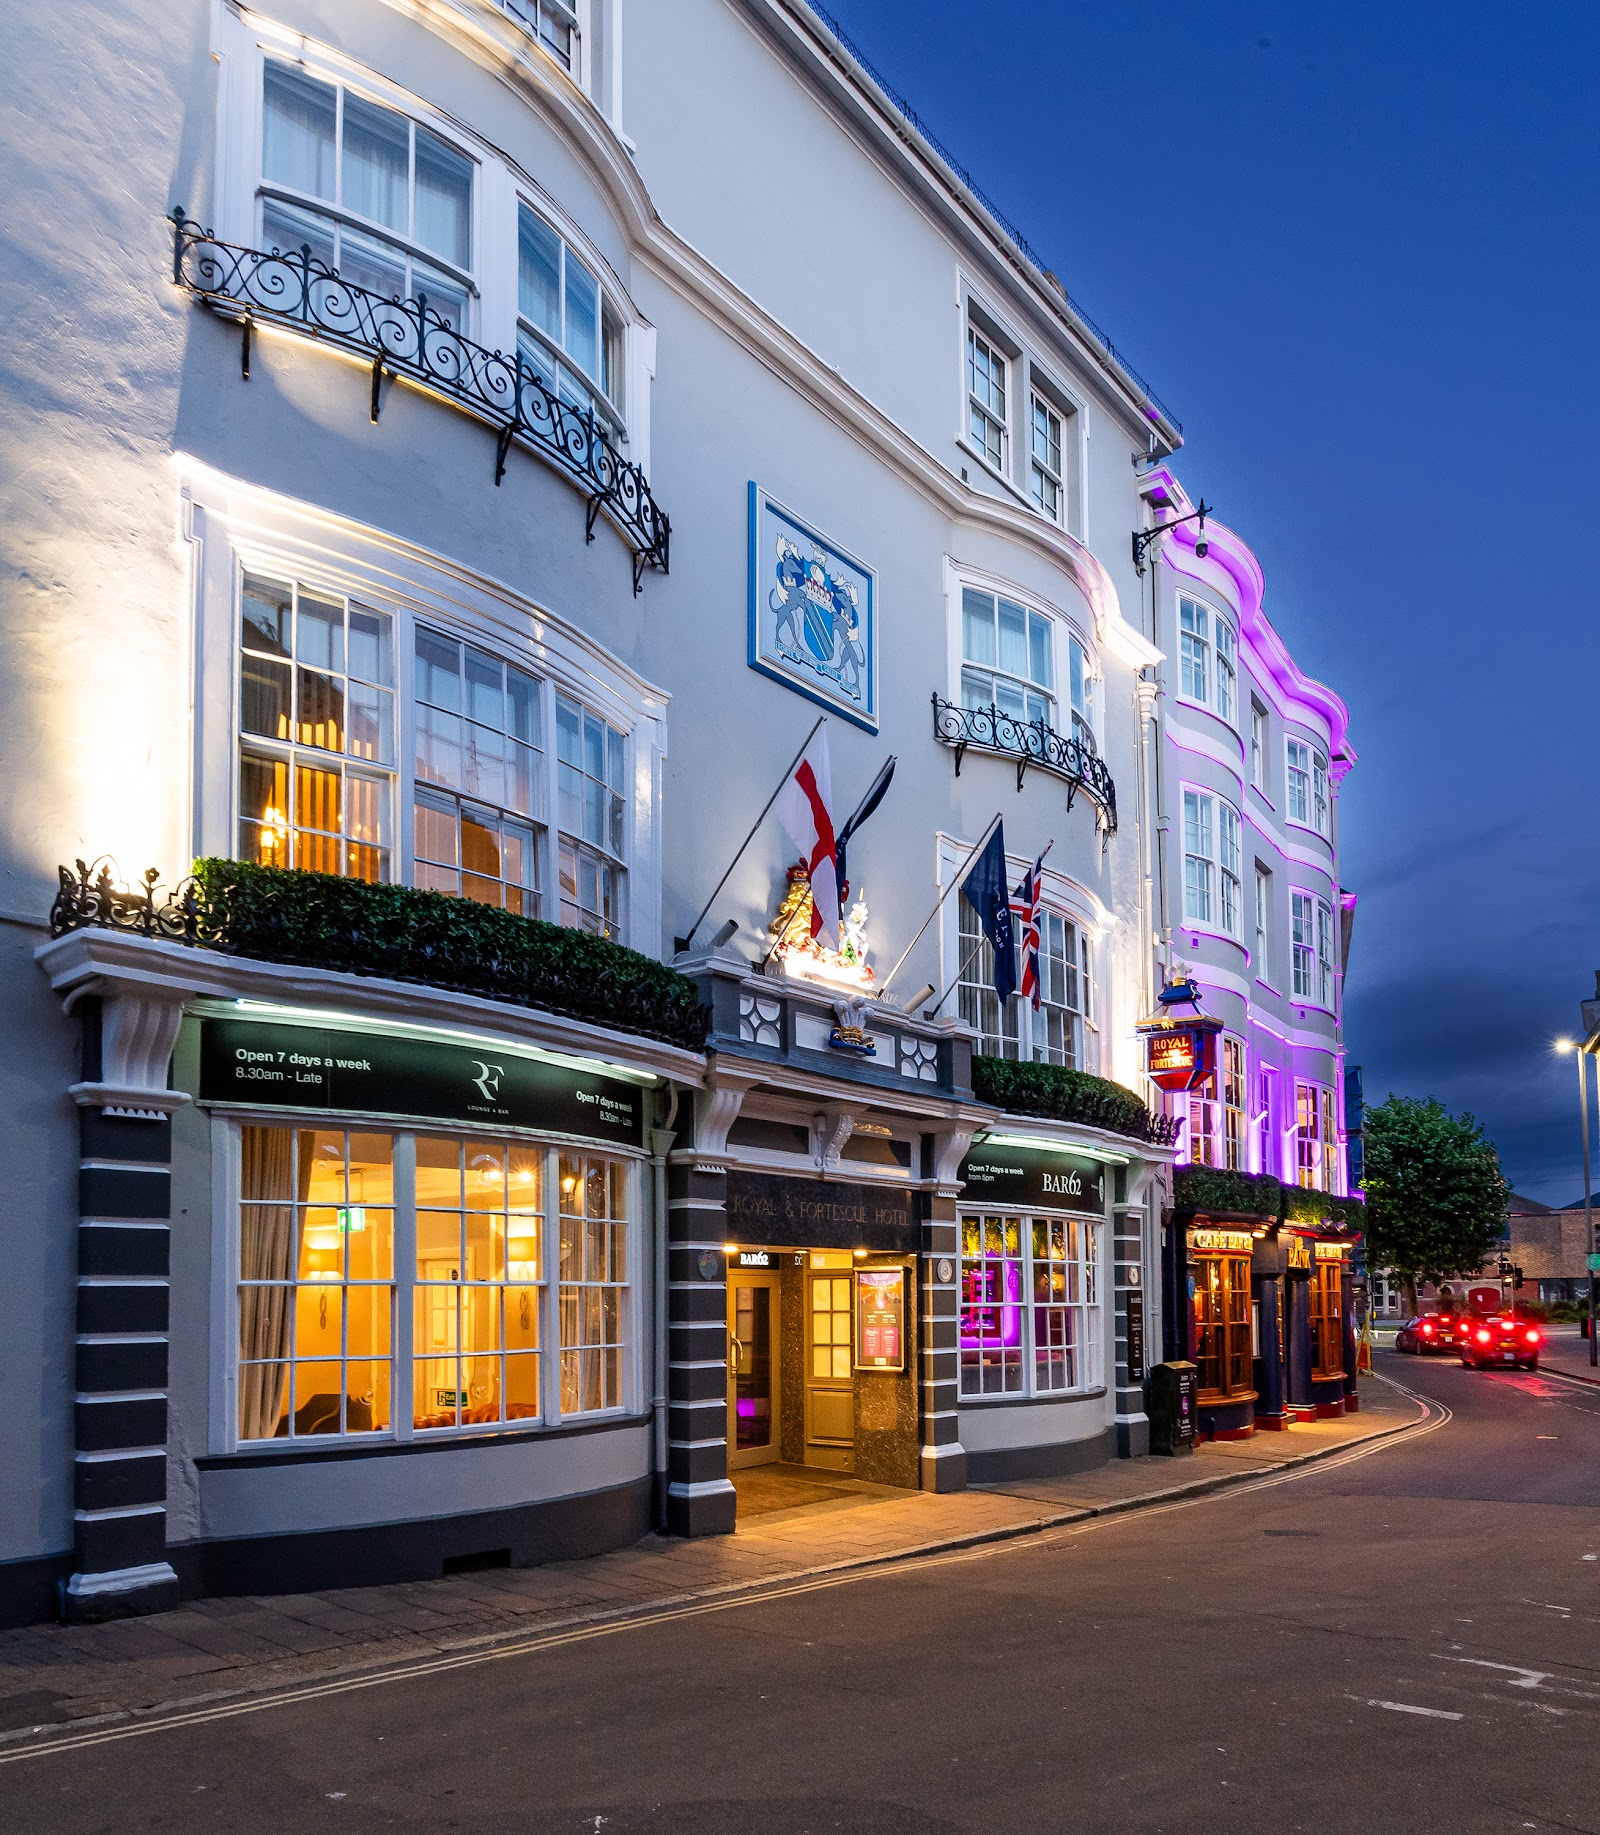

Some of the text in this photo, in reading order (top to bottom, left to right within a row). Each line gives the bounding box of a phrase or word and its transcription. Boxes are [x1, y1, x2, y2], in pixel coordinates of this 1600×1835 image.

[1154, 1037, 1189, 1050] ROYAL
[235, 1048, 371, 1071] Open 7 days a week
[1150, 1056, 1194, 1070] FORTESCUE
[235, 1067, 284, 1081] 8.30am
[295, 1071, 323, 1084] Late
[576, 1090, 595, 1104] Open
[595, 1094, 600, 1104] 7
[600, 1096, 614, 1109] days
[614, 1101, 619, 1109] a
[968, 1163, 985, 1173] Open
[985, 1165, 989, 1173] 7
[990, 1165, 1004, 1174] days
[1004, 1167, 1009, 1175] a
[968, 1173, 982, 1181] from
[1042, 1169, 1082, 1196] BAR62
[734, 1198, 911, 1226] ROYAL & FORTESCUE HOTEL
[740, 1251, 769, 1266] BAR62
[1288, 1247, 1311, 1269] BANK
